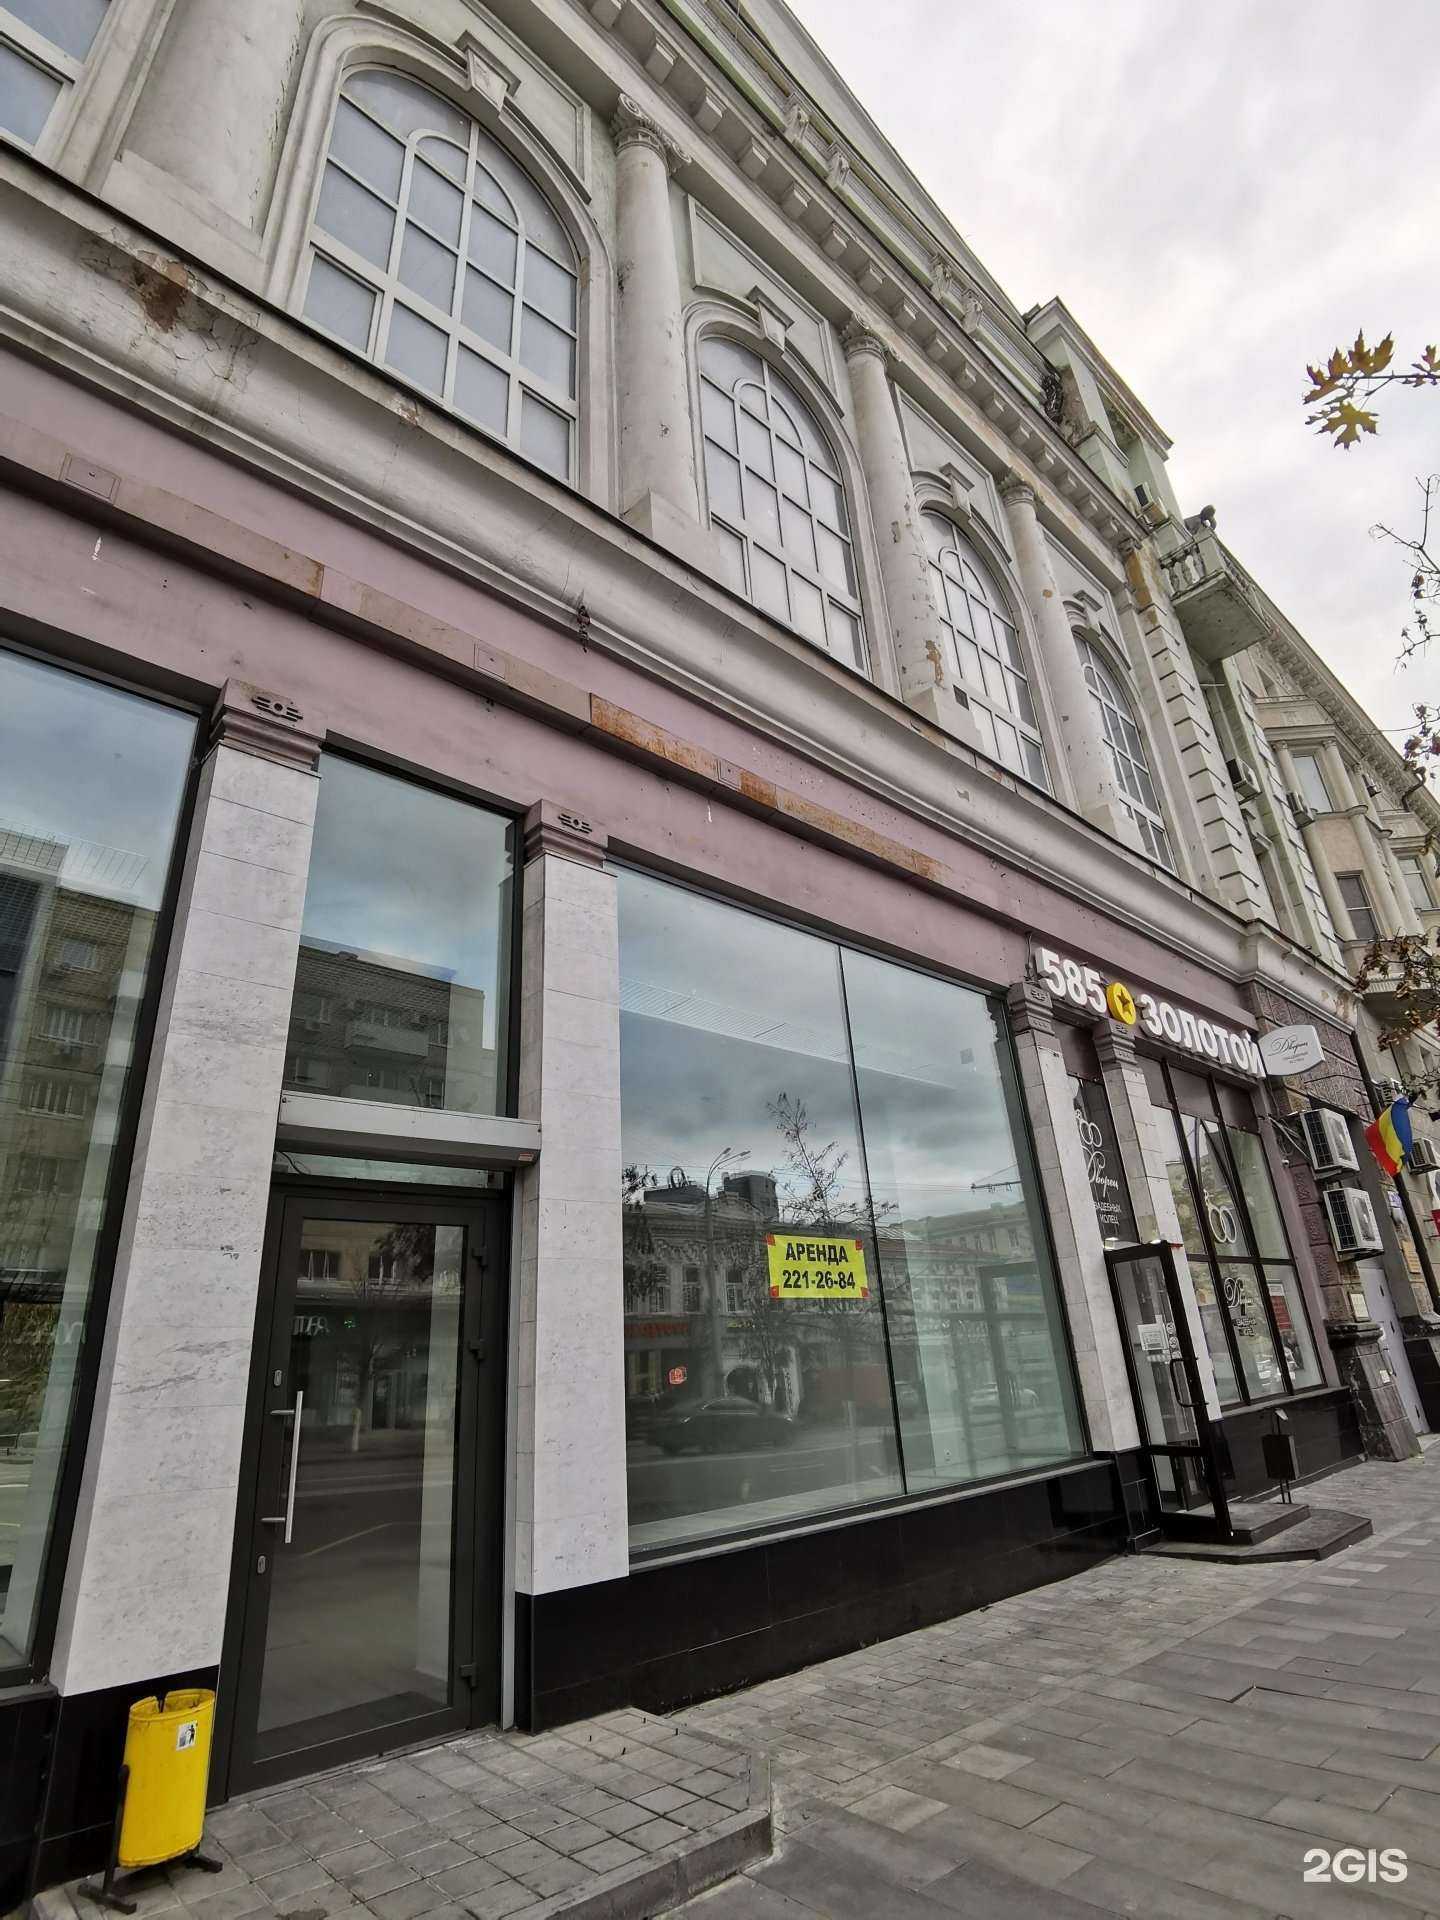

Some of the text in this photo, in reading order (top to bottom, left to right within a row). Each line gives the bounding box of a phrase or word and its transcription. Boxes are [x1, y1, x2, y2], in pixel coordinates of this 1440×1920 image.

[1037, 946, 1267, 1079] 585 ЗОЛОТОЙ
[785, 1242, 849, 1266] АРЕНДА
[782, 1269, 856, 1290] 221-26-84
